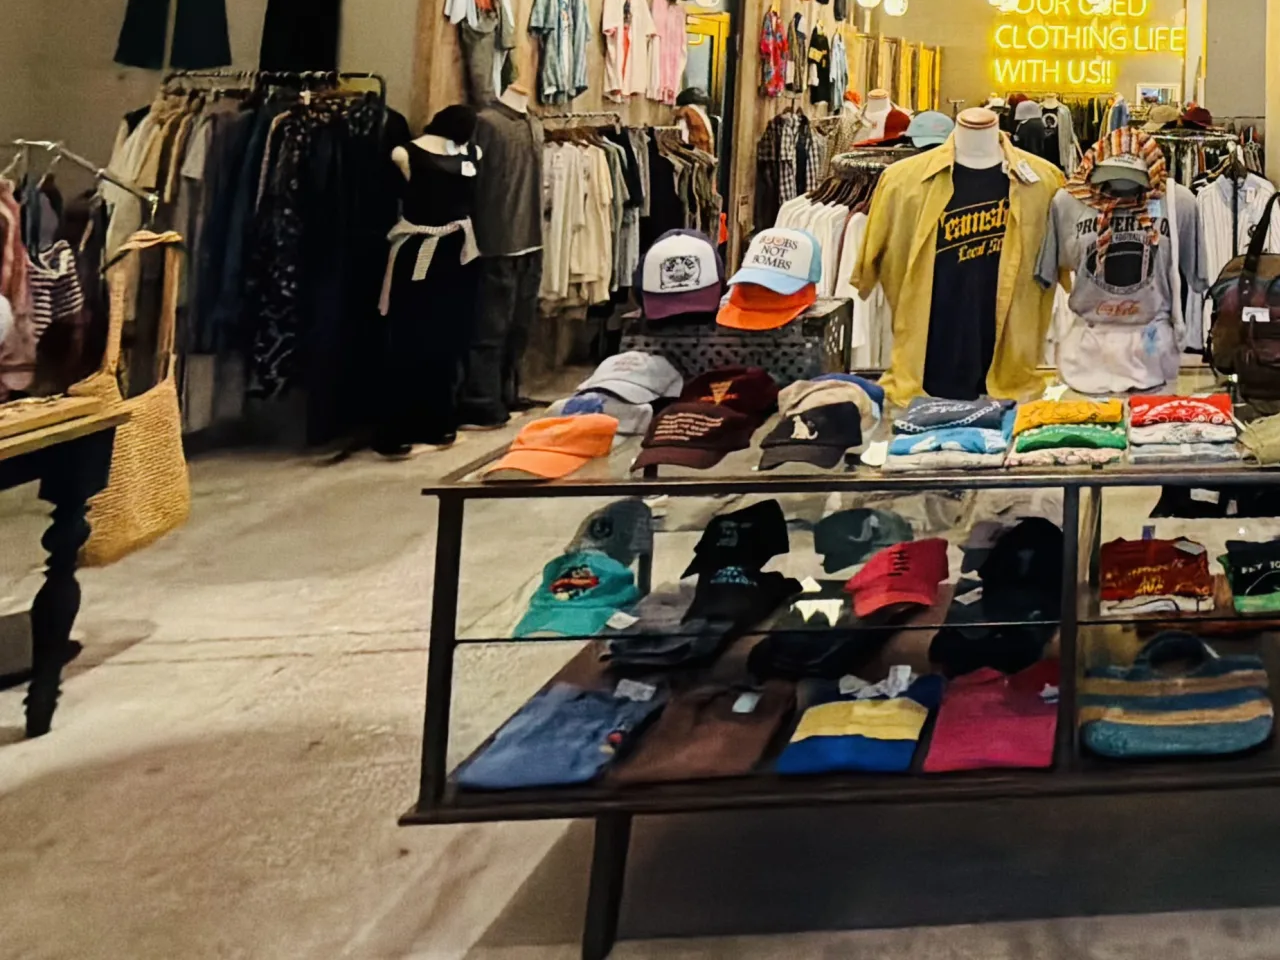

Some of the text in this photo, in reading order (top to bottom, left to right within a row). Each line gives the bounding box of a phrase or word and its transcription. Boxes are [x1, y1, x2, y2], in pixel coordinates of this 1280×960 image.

[994, 24, 1186, 52] CLOTHING LIFE
[994, 58, 1112, 85] WITH US!!
[752, 254, 792, 271] BOMBS
[761, 245, 788, 258] NOT
